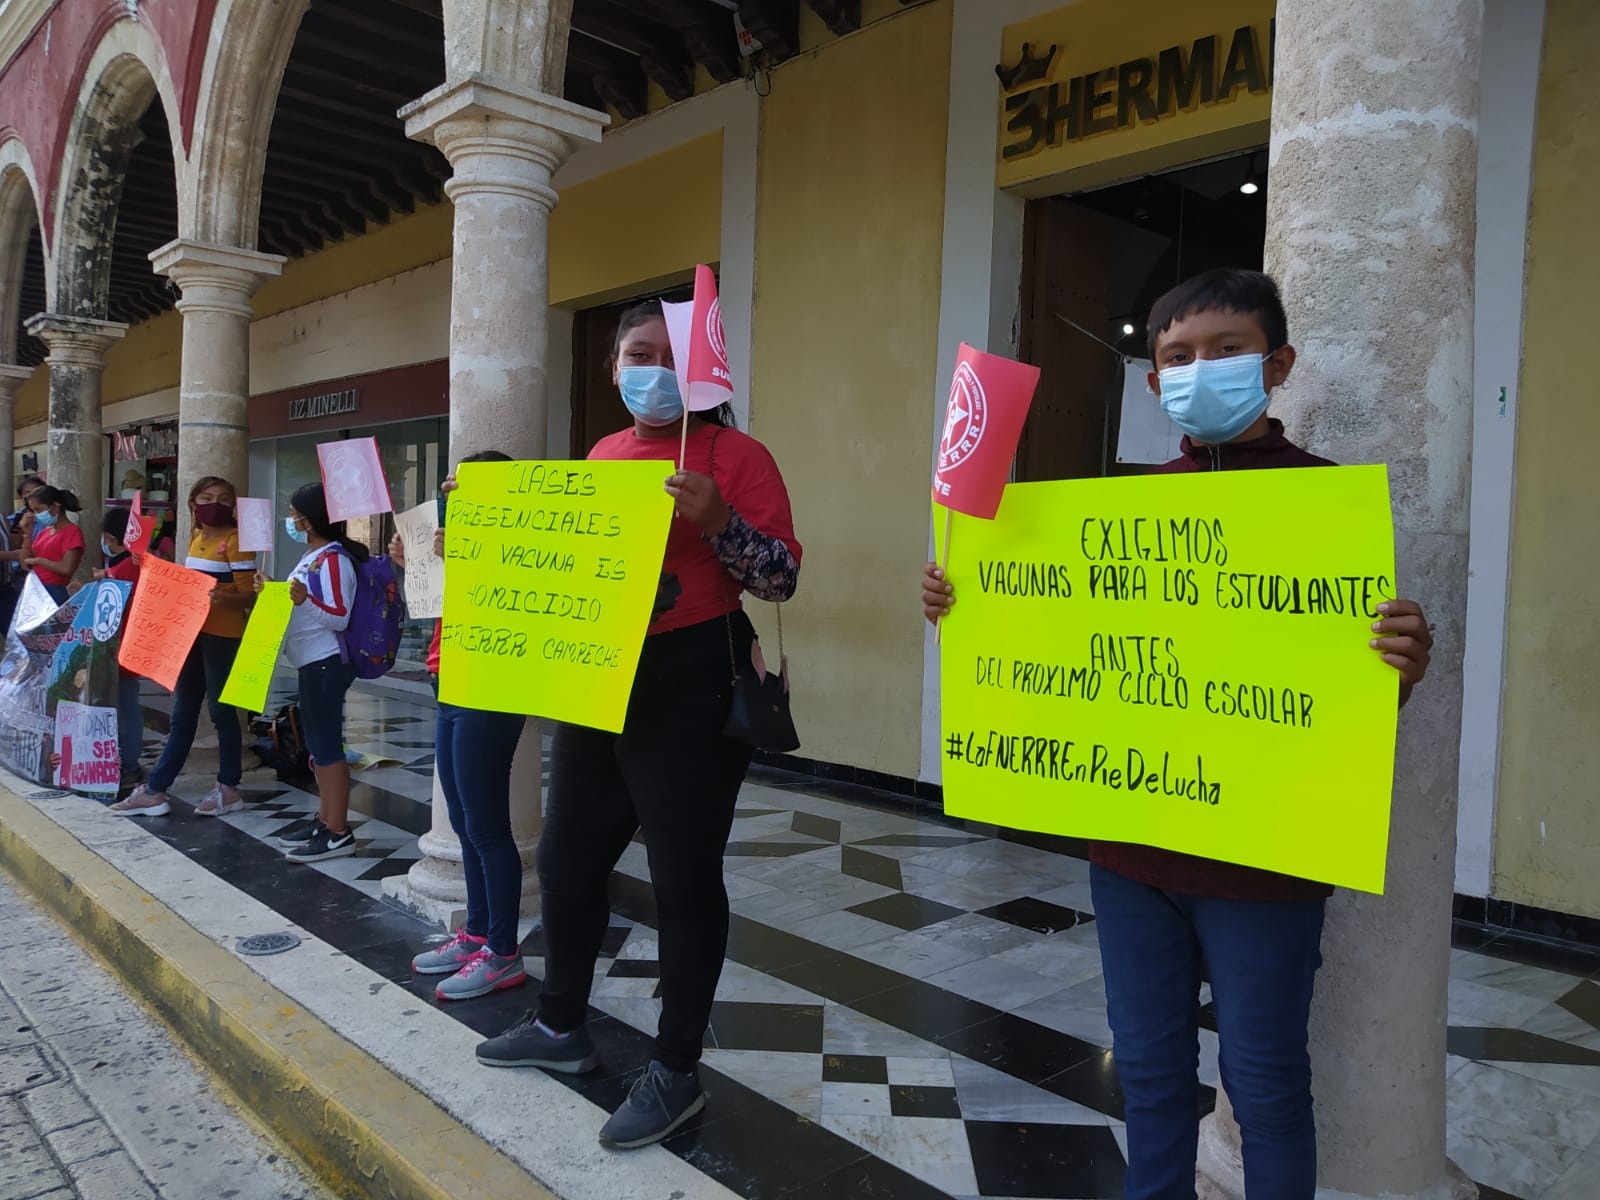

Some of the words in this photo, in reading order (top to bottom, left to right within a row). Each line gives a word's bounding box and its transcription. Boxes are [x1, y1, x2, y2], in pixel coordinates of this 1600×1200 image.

[1002, 18, 1276, 159] 3HERMA
[288, 399, 306, 420] LIZ
[306, 389, 358, 417] MINELLI
[506, 464, 597, 496] CLASES
[450, 500, 621, 537] PRESENCIALES
[447, 537, 482, 560] SIN
[501, 544, 575, 573] VACUNA
[595, 557, 626, 580] ES
[1081, 517, 1228, 566] EXIGIMOS
[978, 560, 1072, 598] VACUNAS
[1089, 565, 1147, 601] PARA
[1163, 567, 1199, 606] LOS
[543, 638, 623, 668] CAMPECHE
[1091, 632, 1180, 678] ANTES
[977, 656, 1004, 689] DEL
[1013, 660, 1101, 701] PROXIMO
[1119, 671, 1188, 709] CICLO
[1205, 680, 1314, 728] ESCOLAR
[93, 739, 117, 759] SER
